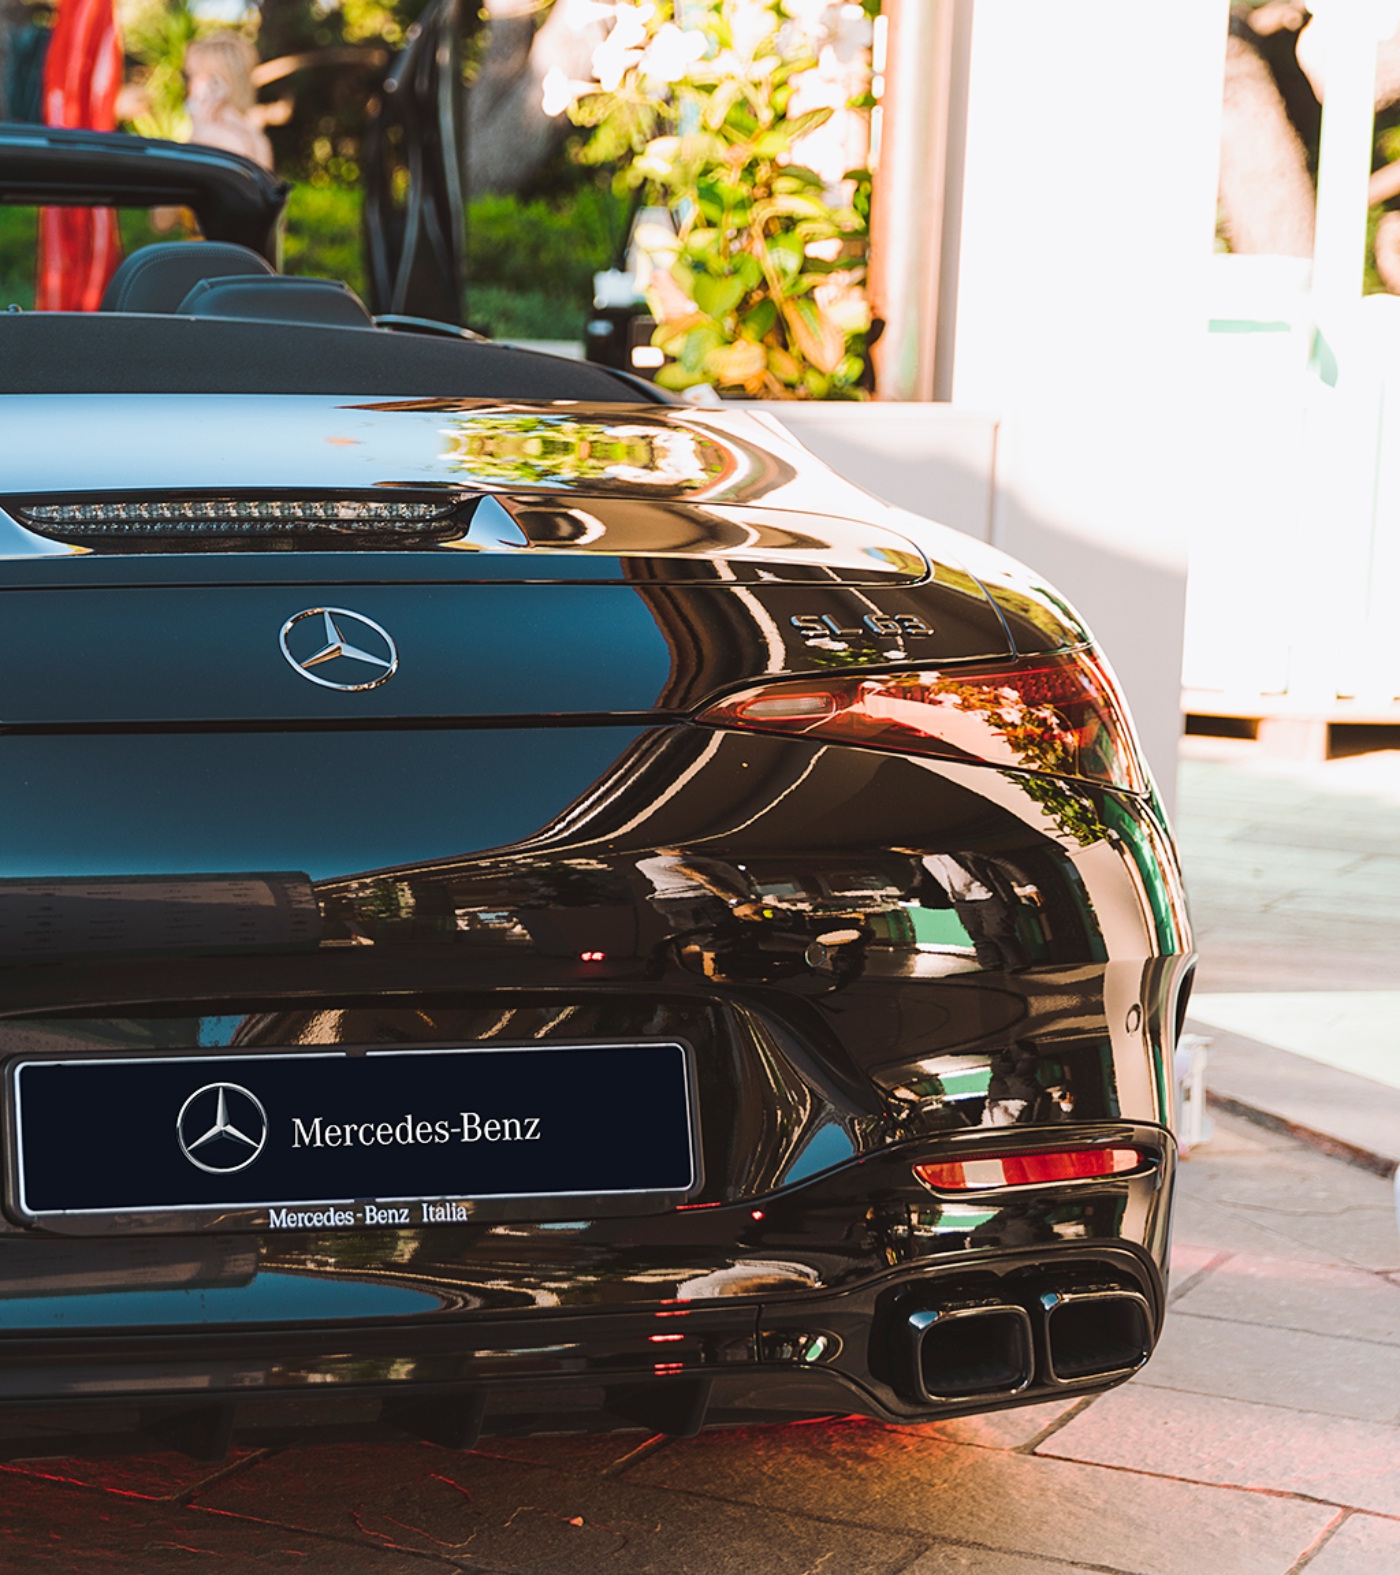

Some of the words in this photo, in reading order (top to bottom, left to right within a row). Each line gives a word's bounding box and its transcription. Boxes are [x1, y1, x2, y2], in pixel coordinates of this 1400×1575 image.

[789, 614, 864, 637] SL
[862, 614, 935, 637] 63
[291, 1111, 542, 1148] Mercedes-Benz
[421, 1202, 468, 1222] Italia
